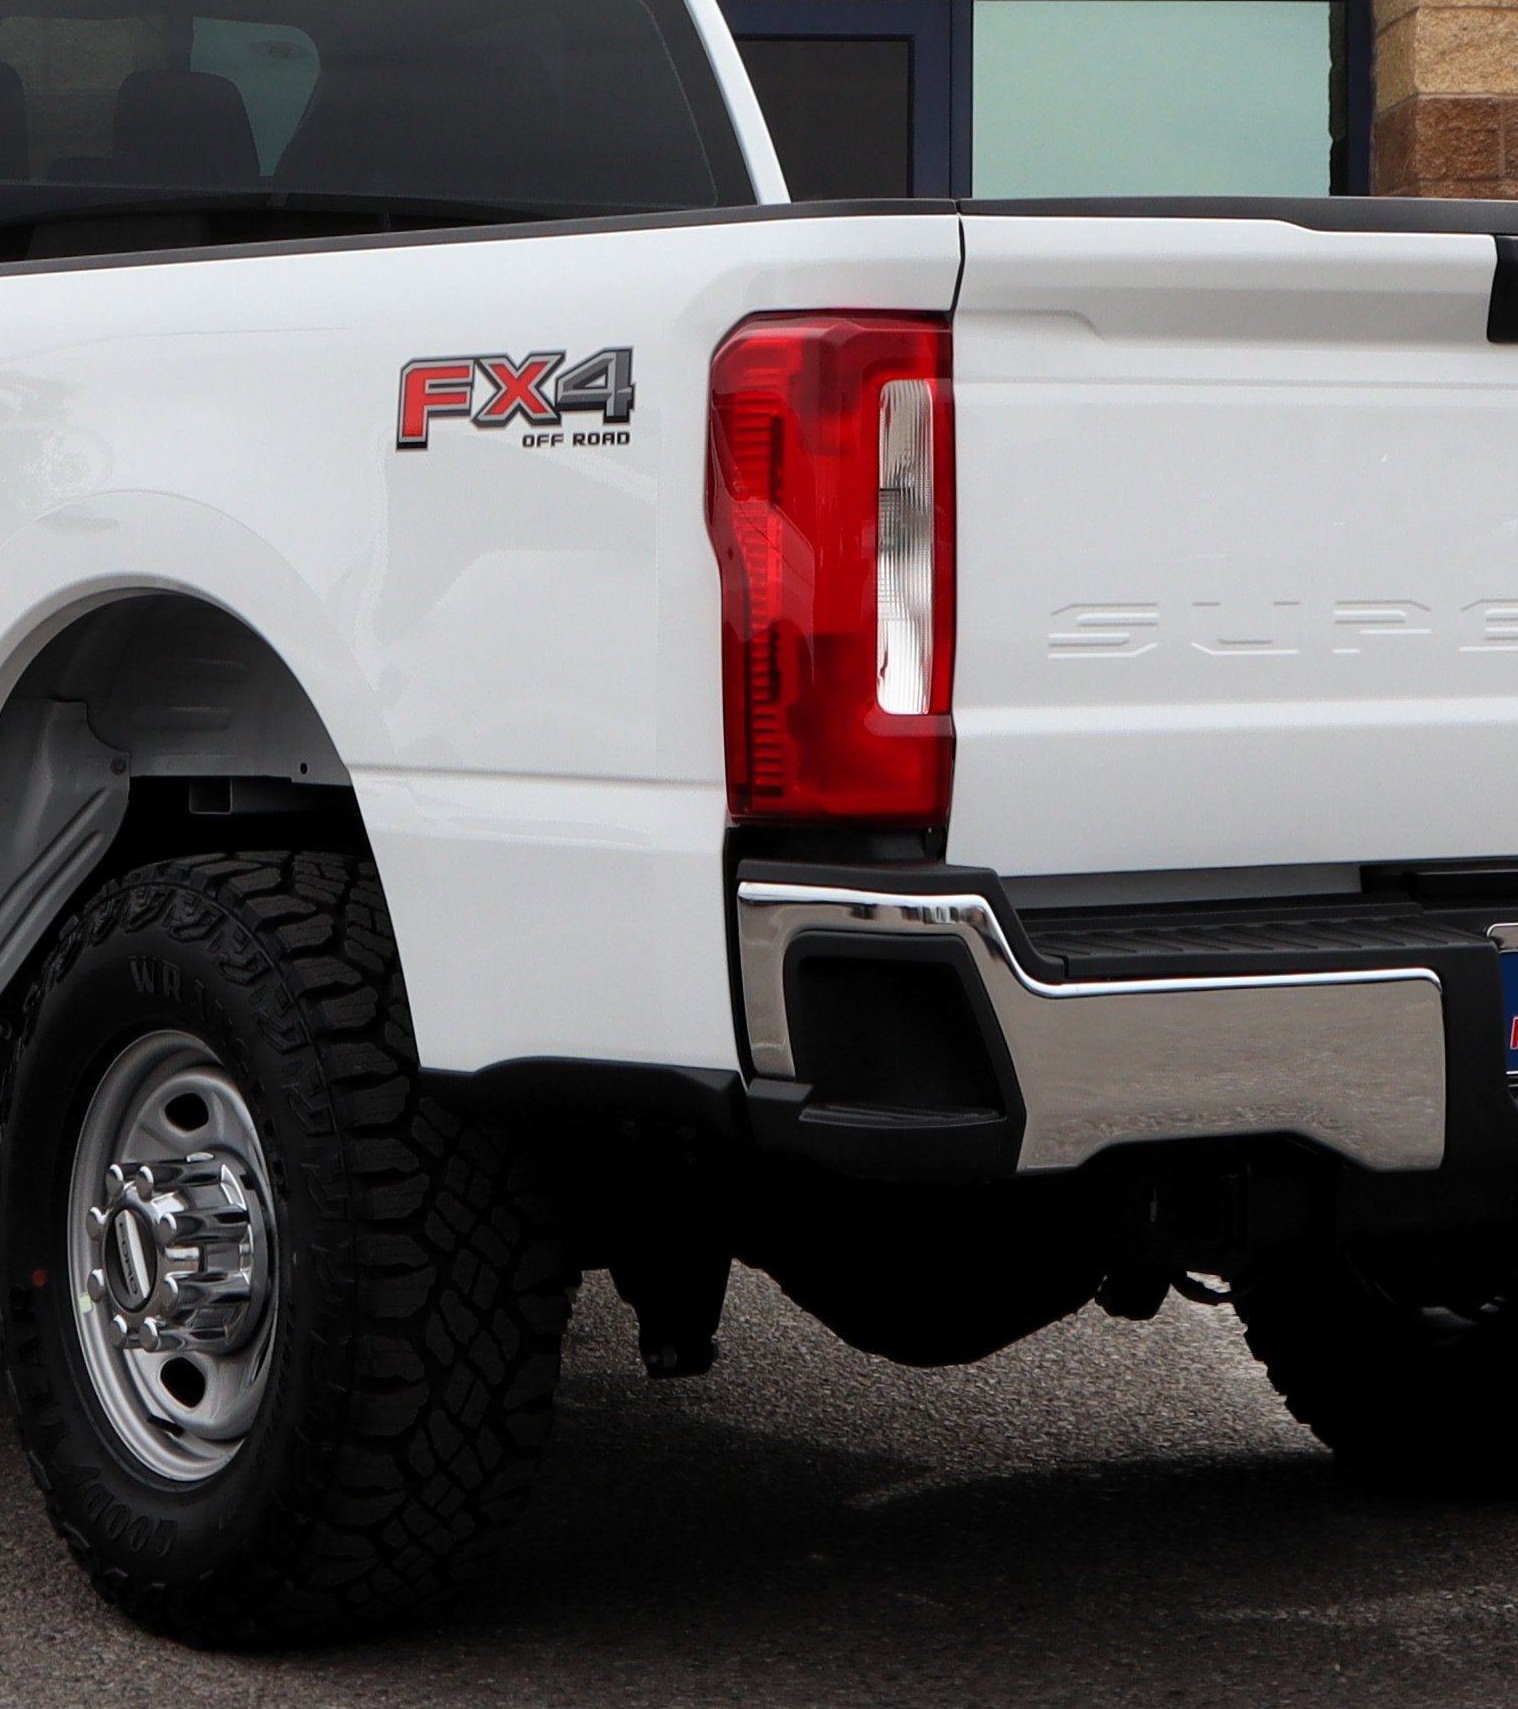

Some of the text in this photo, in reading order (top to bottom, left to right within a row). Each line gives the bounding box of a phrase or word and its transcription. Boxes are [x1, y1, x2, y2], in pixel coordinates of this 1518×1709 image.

[396, 347, 635, 450] FX4
[522, 430, 631, 448] OFF ROAD
[118, 1221, 138, 1295] FORD
[8, 1284, 178, 1558] GOODYEAR
